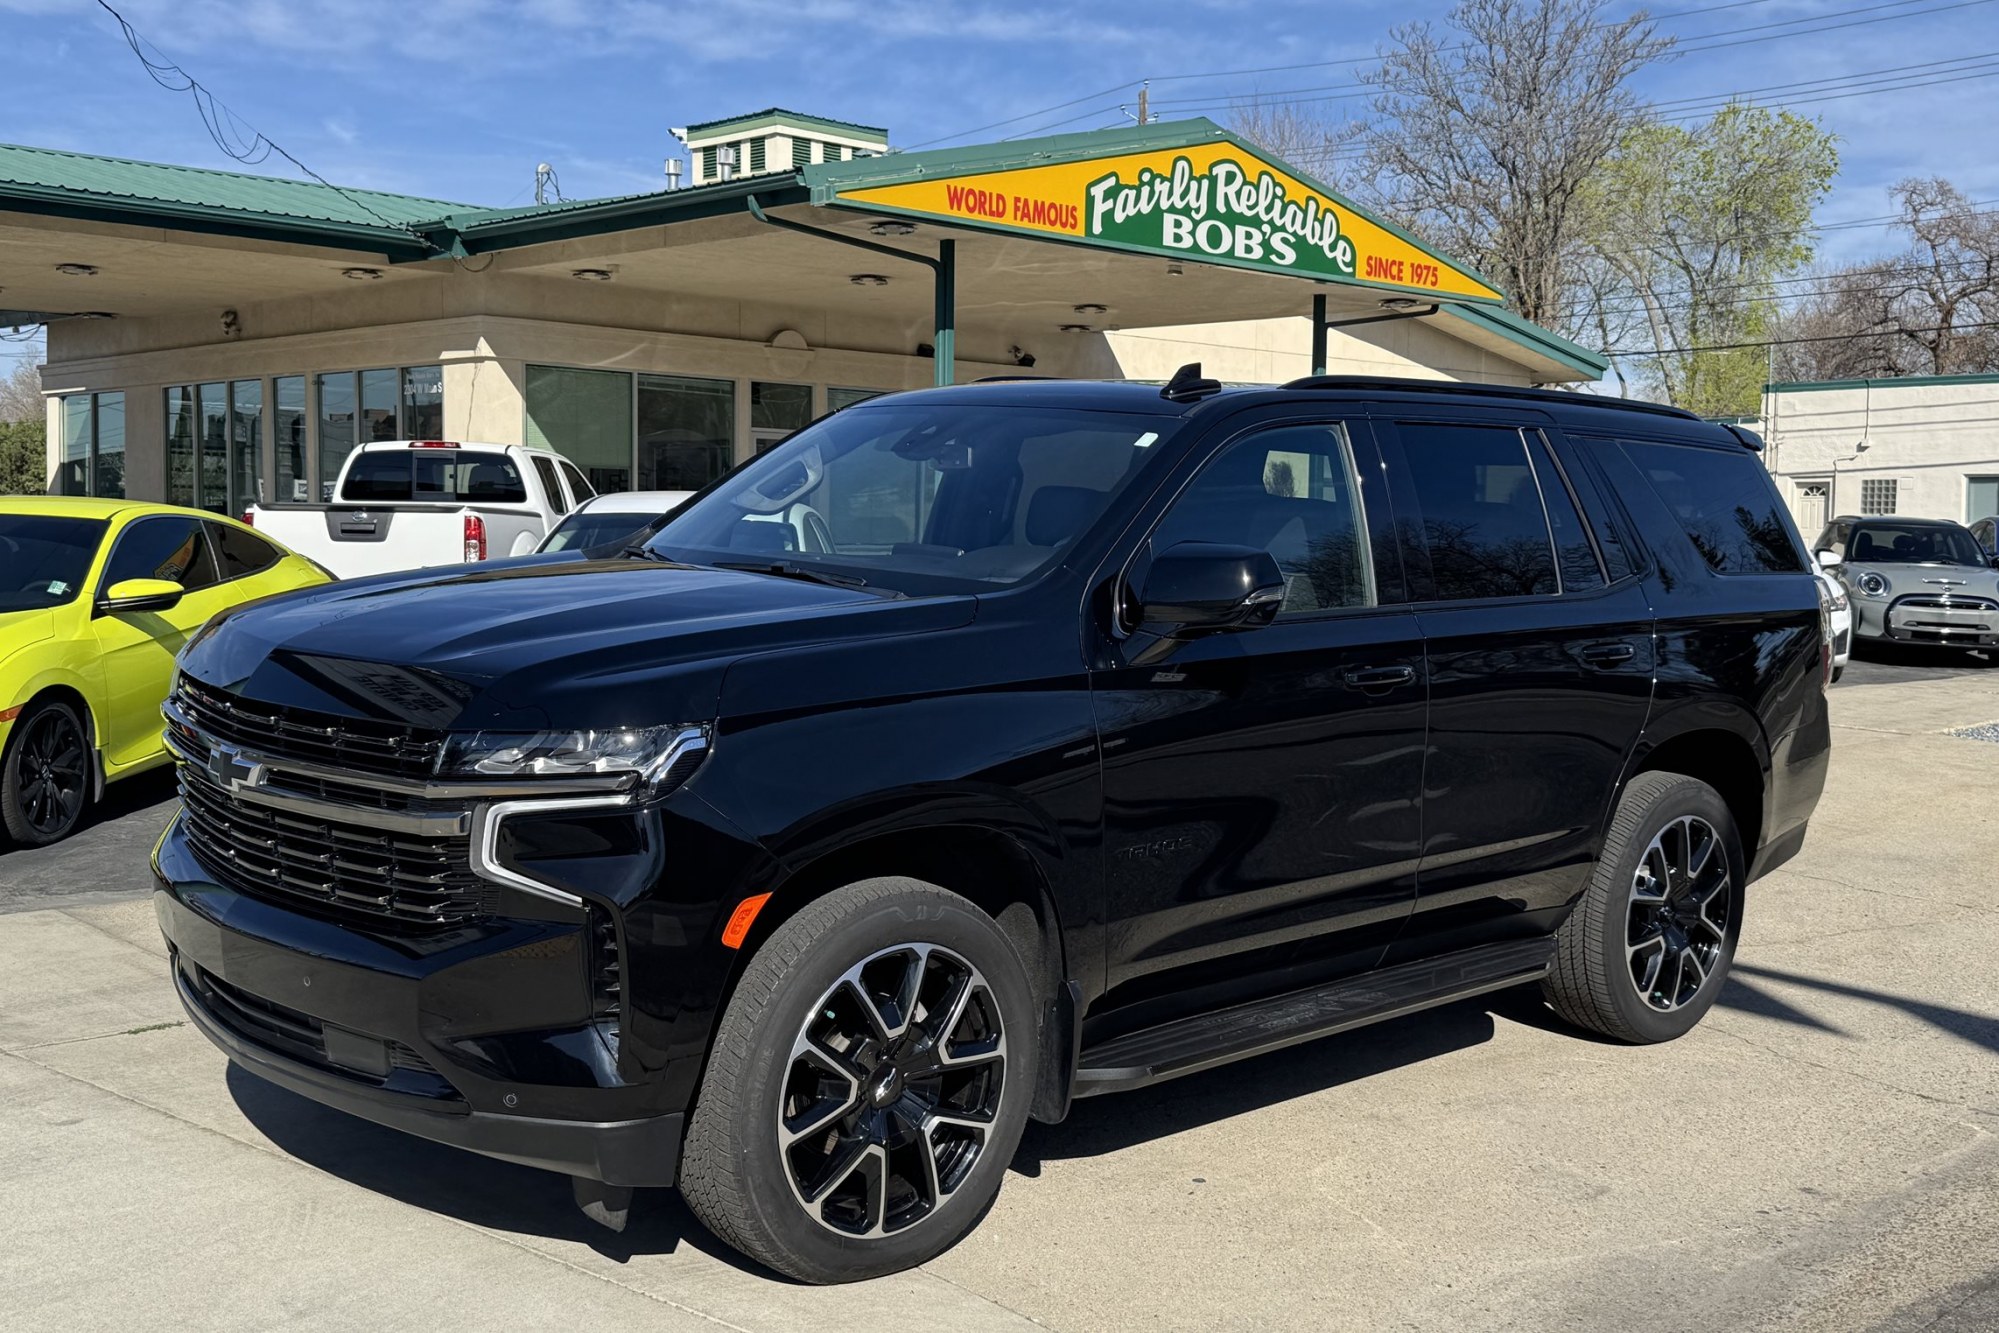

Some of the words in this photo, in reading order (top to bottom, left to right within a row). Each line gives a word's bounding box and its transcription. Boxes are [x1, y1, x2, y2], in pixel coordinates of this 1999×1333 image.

[946, 185, 1007, 219] WORLD
[1013, 197, 1078, 231] FAMOUS
[1090, 160, 1209, 236] Fairly
[1211, 162, 1354, 273] Reliable
[1162, 212, 1297, 266] BOB'S
[1365, 255, 1404, 282] SINCE
[1410, 262, 1439, 287] 1975
